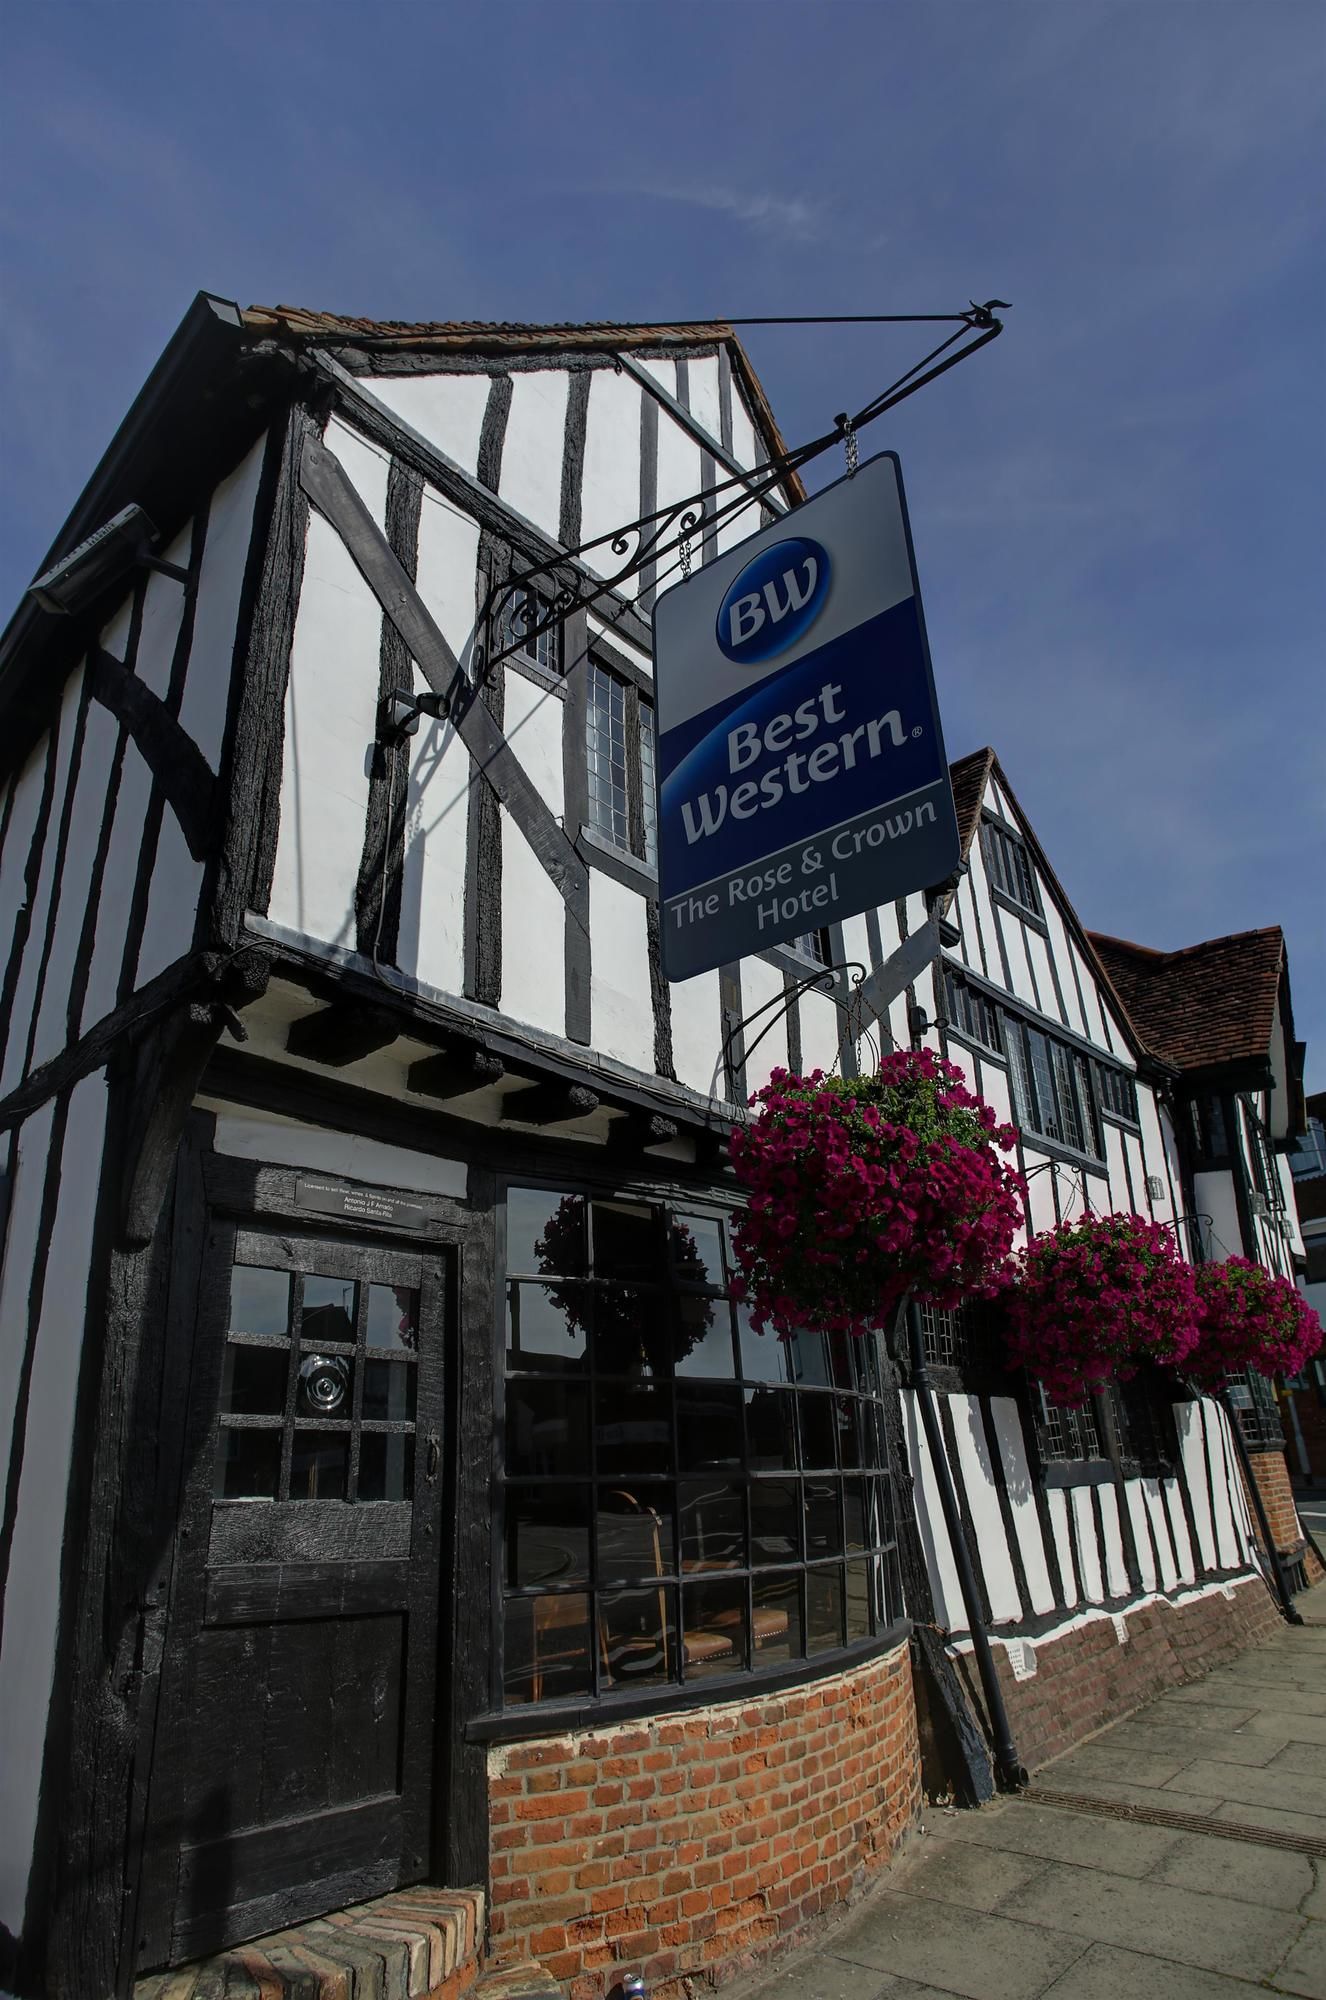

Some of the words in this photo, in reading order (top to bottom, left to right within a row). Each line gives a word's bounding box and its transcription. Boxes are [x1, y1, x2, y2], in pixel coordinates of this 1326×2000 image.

[729, 557, 818, 647] BW
[727, 682, 846, 774] Best
[680, 709, 908, 846] Western
[671, 893, 720, 929] The
[728, 862, 793, 907] Rose
[801, 845, 824, 875] &
[831, 800, 937, 860] Crown
[757, 873, 839, 930] Hotel
[344, 1196, 365, 1206] Antonio
[344, 1203, 365, 1213] Ricardo
